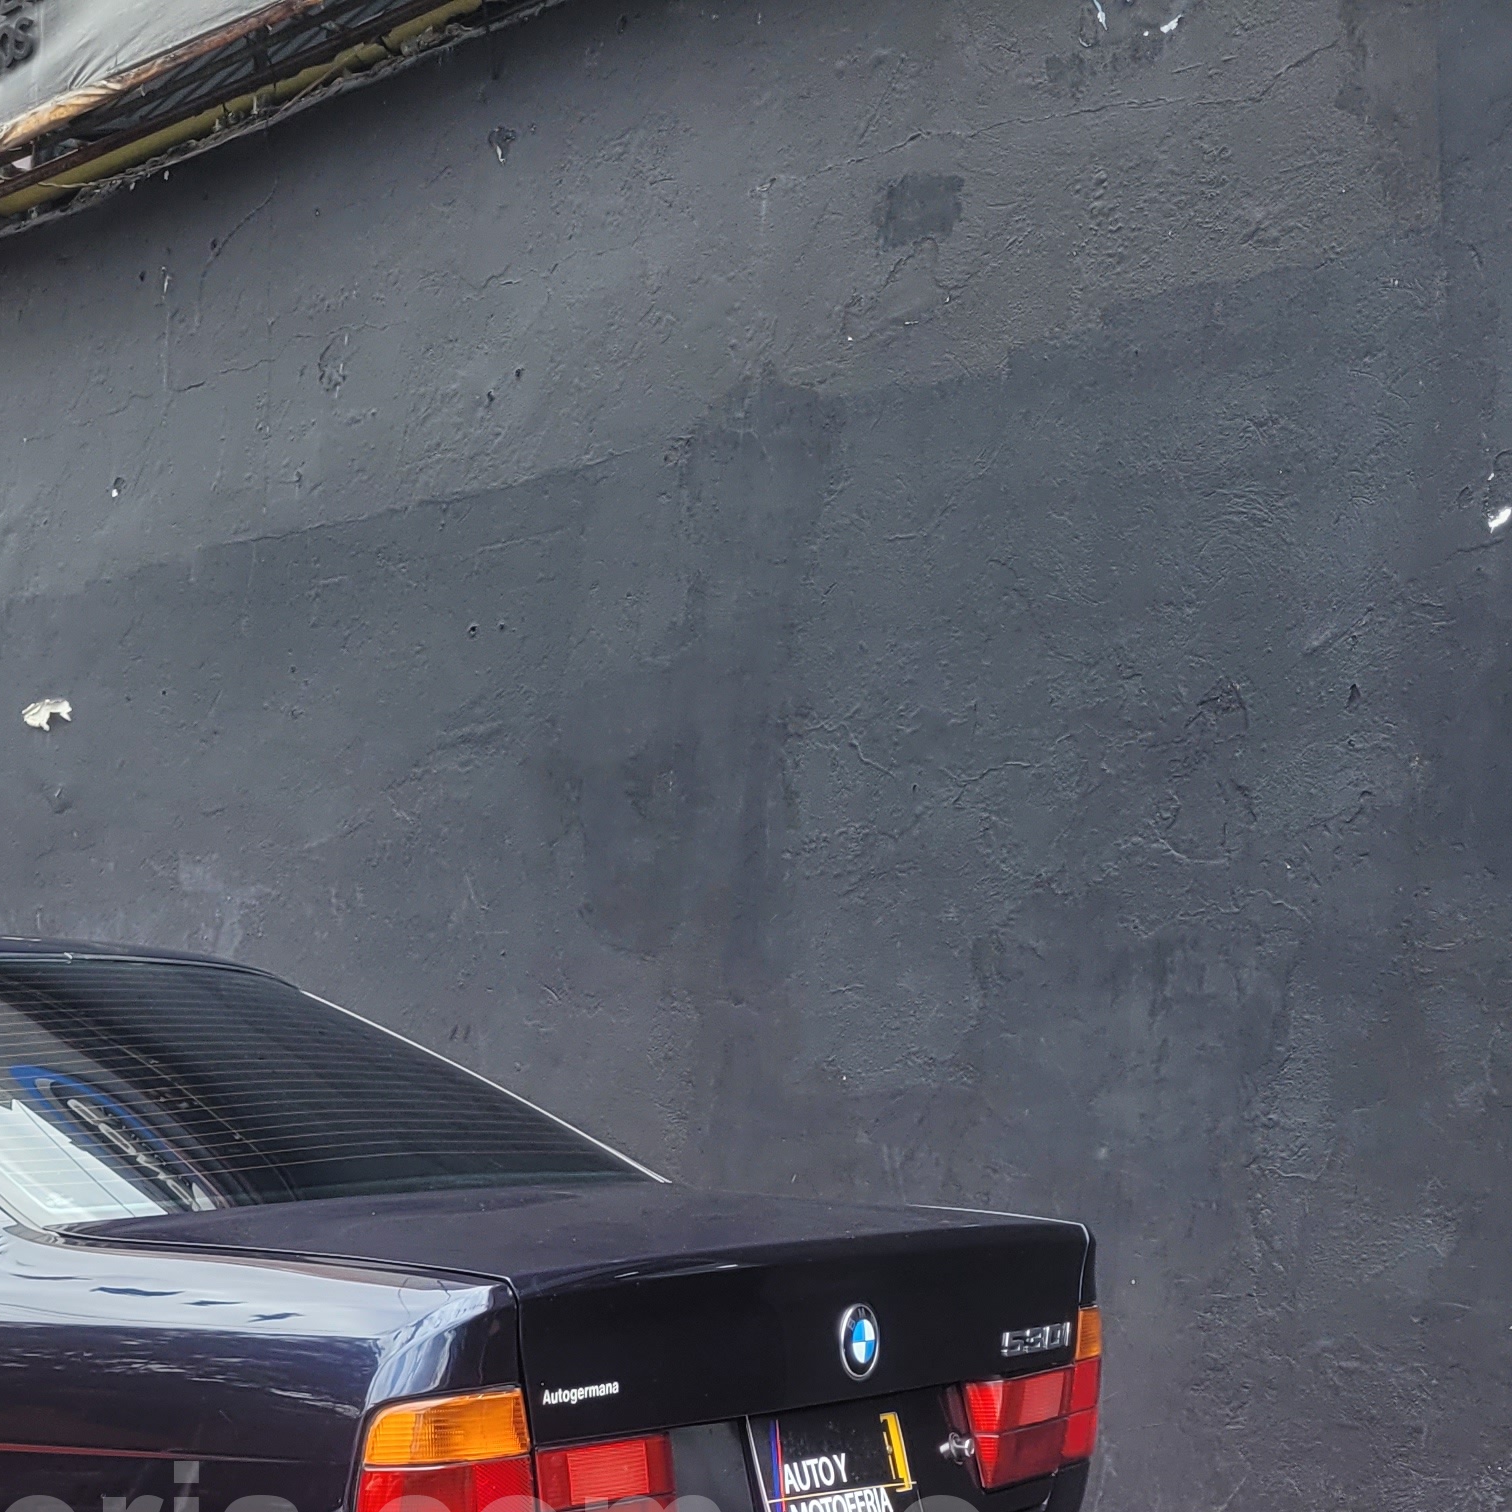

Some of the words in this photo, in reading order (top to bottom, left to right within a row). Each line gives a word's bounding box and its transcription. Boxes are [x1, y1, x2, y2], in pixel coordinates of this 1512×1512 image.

[542, 1381, 619, 1406] Autogermana
[783, 1456, 835, 1494] AUTO
[832, 1453, 847, 1483] Y
